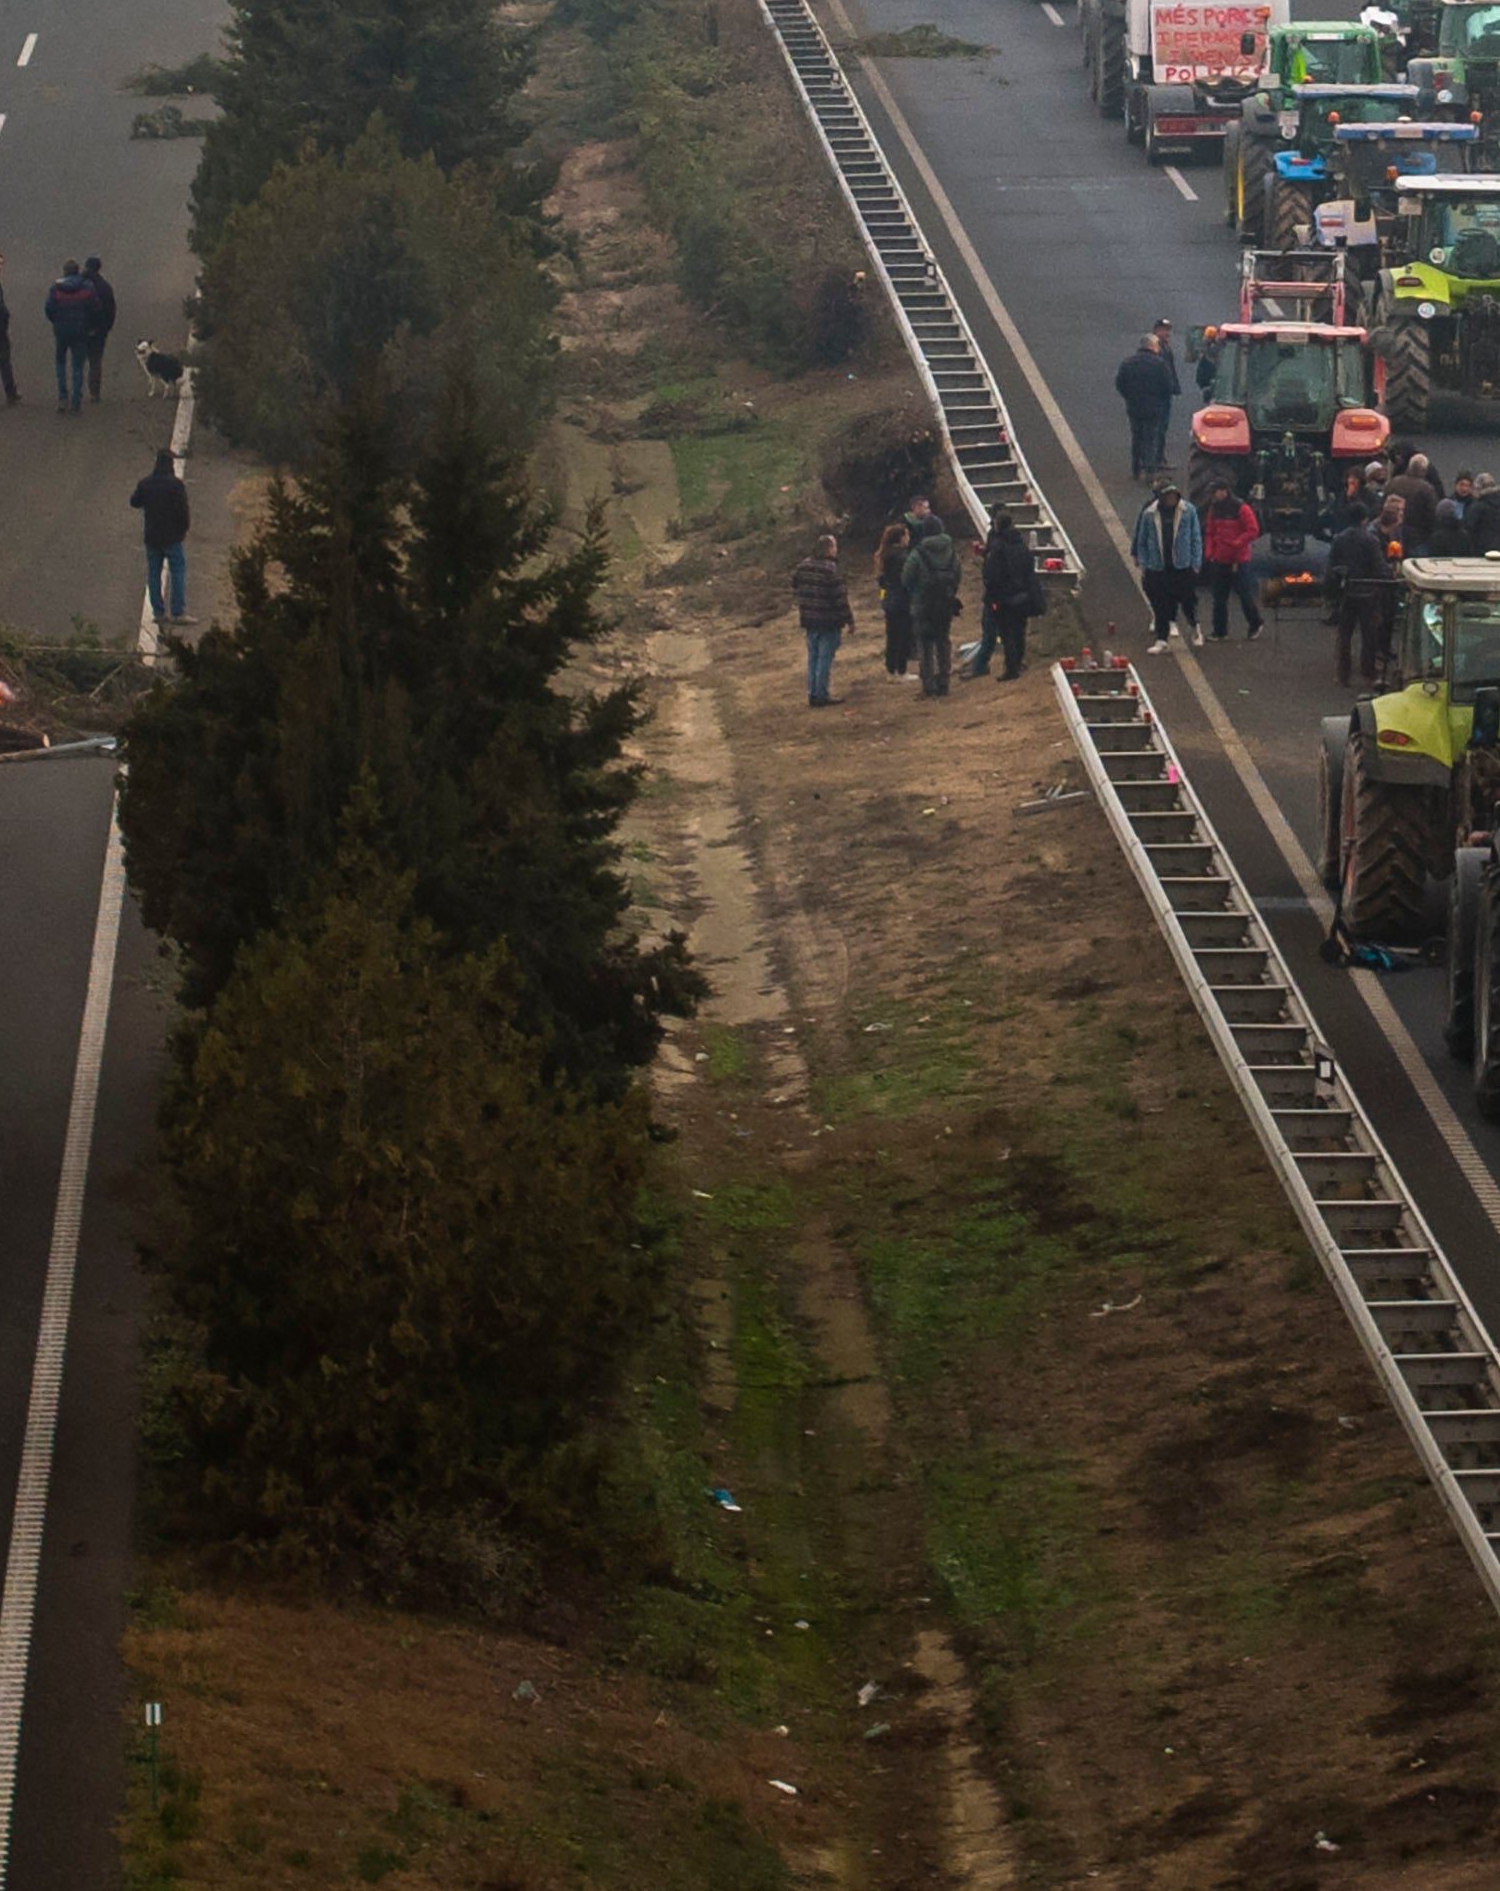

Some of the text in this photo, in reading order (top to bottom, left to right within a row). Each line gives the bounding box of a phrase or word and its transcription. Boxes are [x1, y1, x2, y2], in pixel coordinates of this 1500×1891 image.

[1156, 3, 1266, 27] MÉS PORCS
[1158, 31, 1169, 46] I
